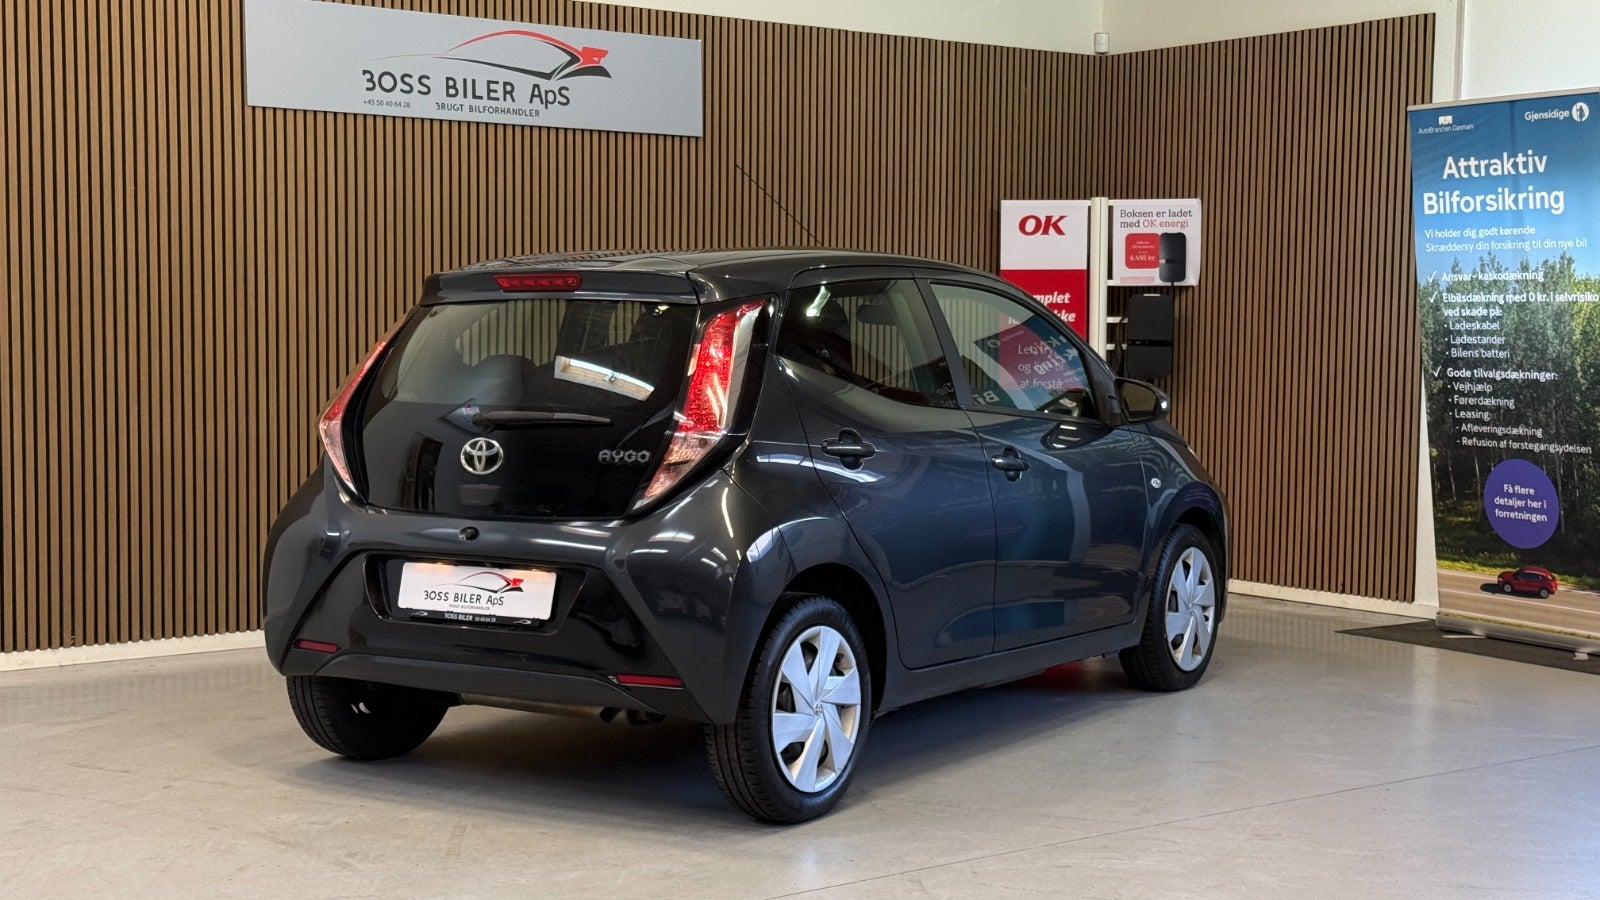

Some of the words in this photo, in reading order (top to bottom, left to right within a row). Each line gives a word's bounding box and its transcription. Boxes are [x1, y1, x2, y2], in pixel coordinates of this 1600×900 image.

[445, 76, 516, 103] BILER
[529, 83, 571, 109] ApS
[469, 104, 540, 118] BILFORHANDLER
[1524, 109, 1570, 123] Gjensidige
[1442, 149, 1548, 180] Attraktiv
[1423, 185, 1565, 215] Bilforsikring
[1120, 209, 1154, 218] Boksen
[1168, 208, 1193, 218] ladet
[1018, 214, 1068, 236] OK
[1120, 219, 1140, 228] med
[1142, 219, 1157, 228] OK
[1159, 219, 1190, 230] energi
[1424, 229, 1434, 238] Vi
[1434, 229, 1461, 238] holder
[1463, 228, 1476, 239] dig
[1478, 227, 1498, 238] godt
[1500, 225, 1536, 236] kørende
[1426, 243, 1474, 253] Skræddersy
[1476, 242, 1489, 251] din
[1490, 240, 1531, 251] forsikring
[1532, 240, 1541, 249] til
[1543, 239, 1556, 248] din
[1558, 240, 1574, 250] nye
[1576, 238, 1588, 248] bil
[1442, 272, 1476, 281] Ansvar-
[1478, 271, 1544, 282] kaskodækning
[1442, 293, 1505, 304] Elbilsdækning
[1506, 293, 1526, 302] med
[1528, 293, 1535, 302] 0
[1537, 293, 1550, 302] kr.
[1555, 293, 1600, 302] selvrisiko
[1444, 306, 1460, 316] ved
[1460, 306, 1488, 316] skade
[1490, 306, 1503, 318] på:
[1450, 321, 1500, 331] Ladeskabel
[1450, 335, 1506, 344] Ladestander
[1451, 348, 1479, 358] Bilens
[1480, 349, 1510, 359] batteri
[1446, 368, 1472, 378] Gode
[1474, 368, 1559, 382] tilvalgsdækninger:
[1453, 382, 1493, 393] Vejhjælp
[1454, 396, 1516, 409] Førerdækning
[1454, 410, 1492, 421] Leasing:
[1461, 424, 1543, 438] Afleveringsdækning
[1462, 437, 1498, 448] Refusion
[1499, 439, 1508, 448] af
[1508, 440, 1592, 454] førstegangsydelsen
[598, 449, 650, 463] AYGO
[1504, 484, 1513, 493] Få
[1514, 485, 1535, 496] flere
[1494, 496, 1526, 508] detaljer
[1527, 498, 1542, 508] her
[1494, 508, 1548, 523] forretningen
[453, 592, 482, 604] BILER
[486, 595, 505, 608] ApS
